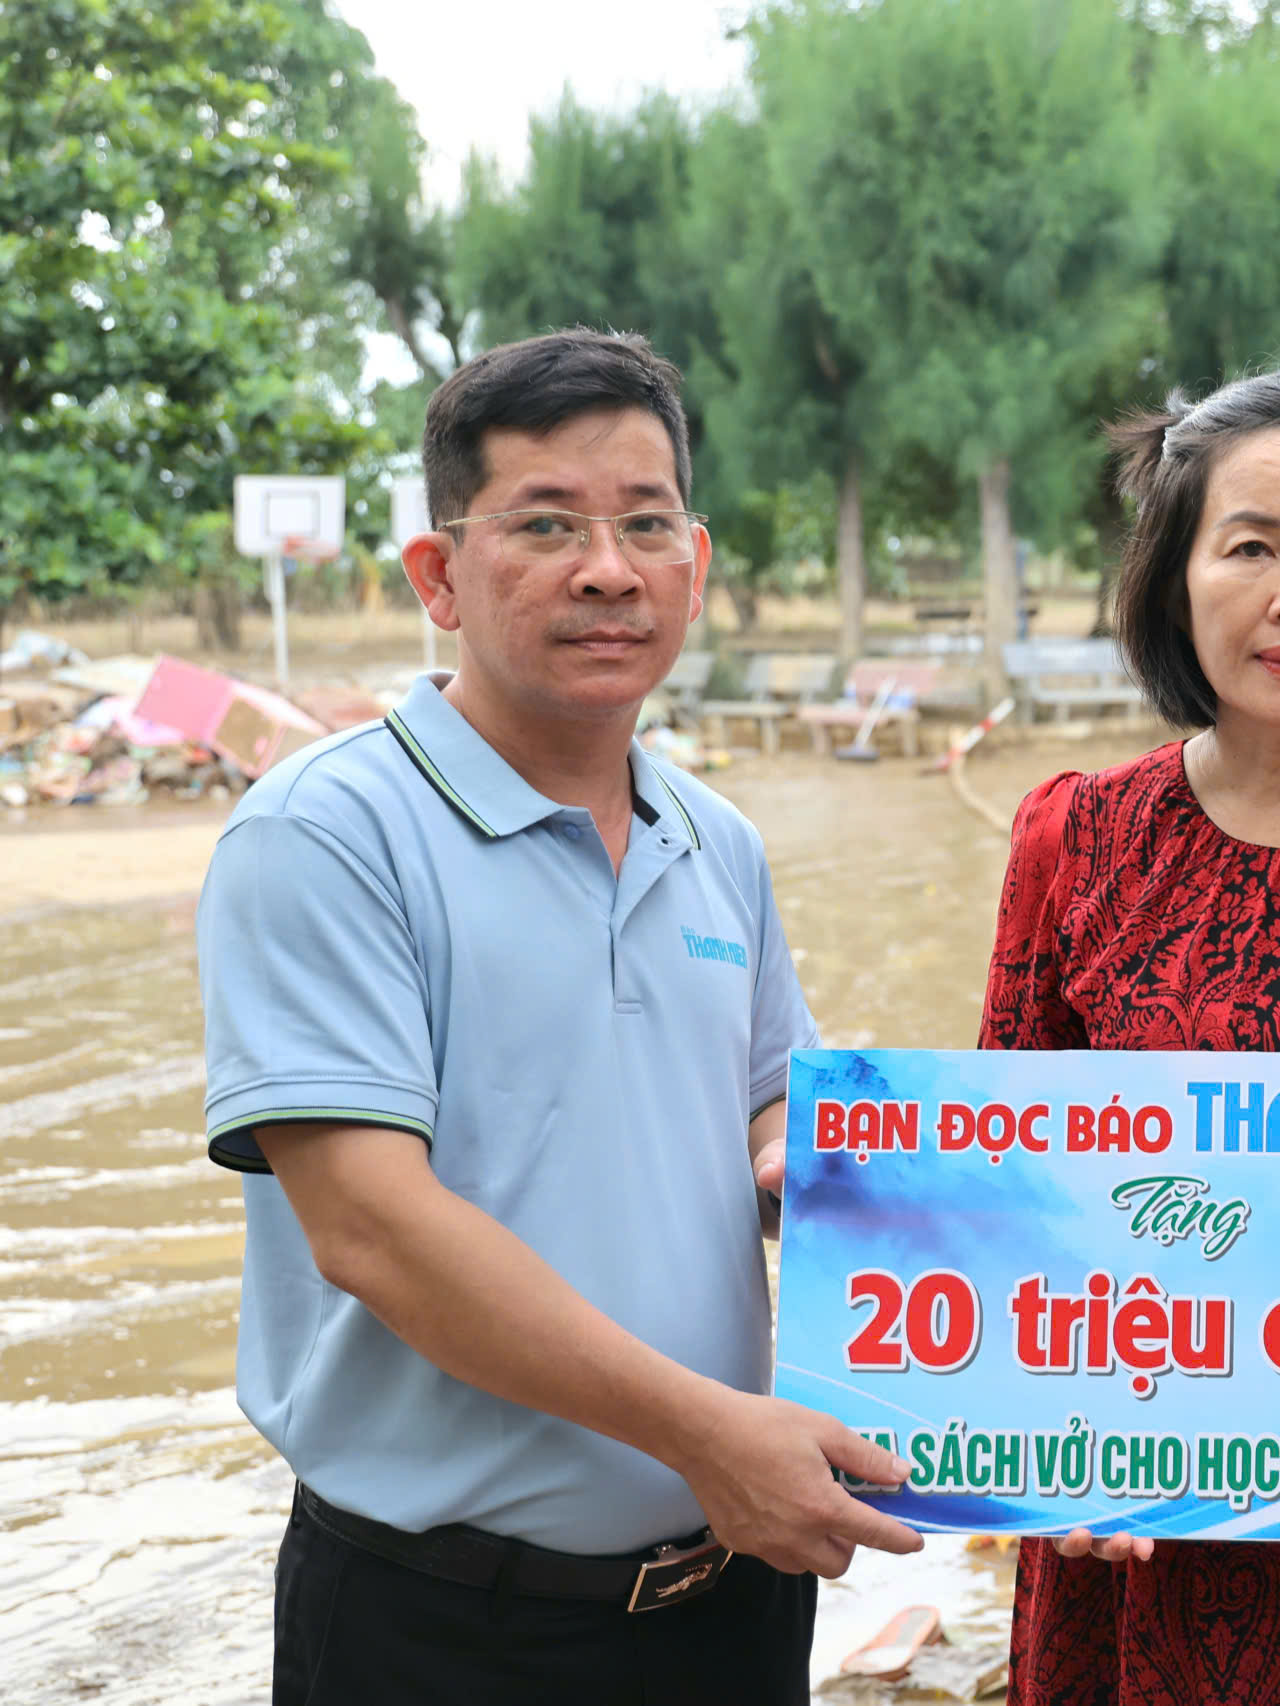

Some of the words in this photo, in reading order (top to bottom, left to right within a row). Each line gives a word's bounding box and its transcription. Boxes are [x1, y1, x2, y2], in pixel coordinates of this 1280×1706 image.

[816, 1101, 920, 1162] BẠN
[937, 1103, 1049, 1164] ĐỌC
[1066, 1094, 1174, 1154] BÁO
[1111, 1175, 1246, 1256] Tặng
[847, 1272, 976, 1369] 20
[1012, 1272, 1227, 1393] triệu
[910, 1422, 1021, 1488] SÁCH
[1034, 1416, 1089, 1490] VỞ
[1101, 1435, 1184, 1491] CHO
[1198, 1437, 1280, 1504] HỌC
